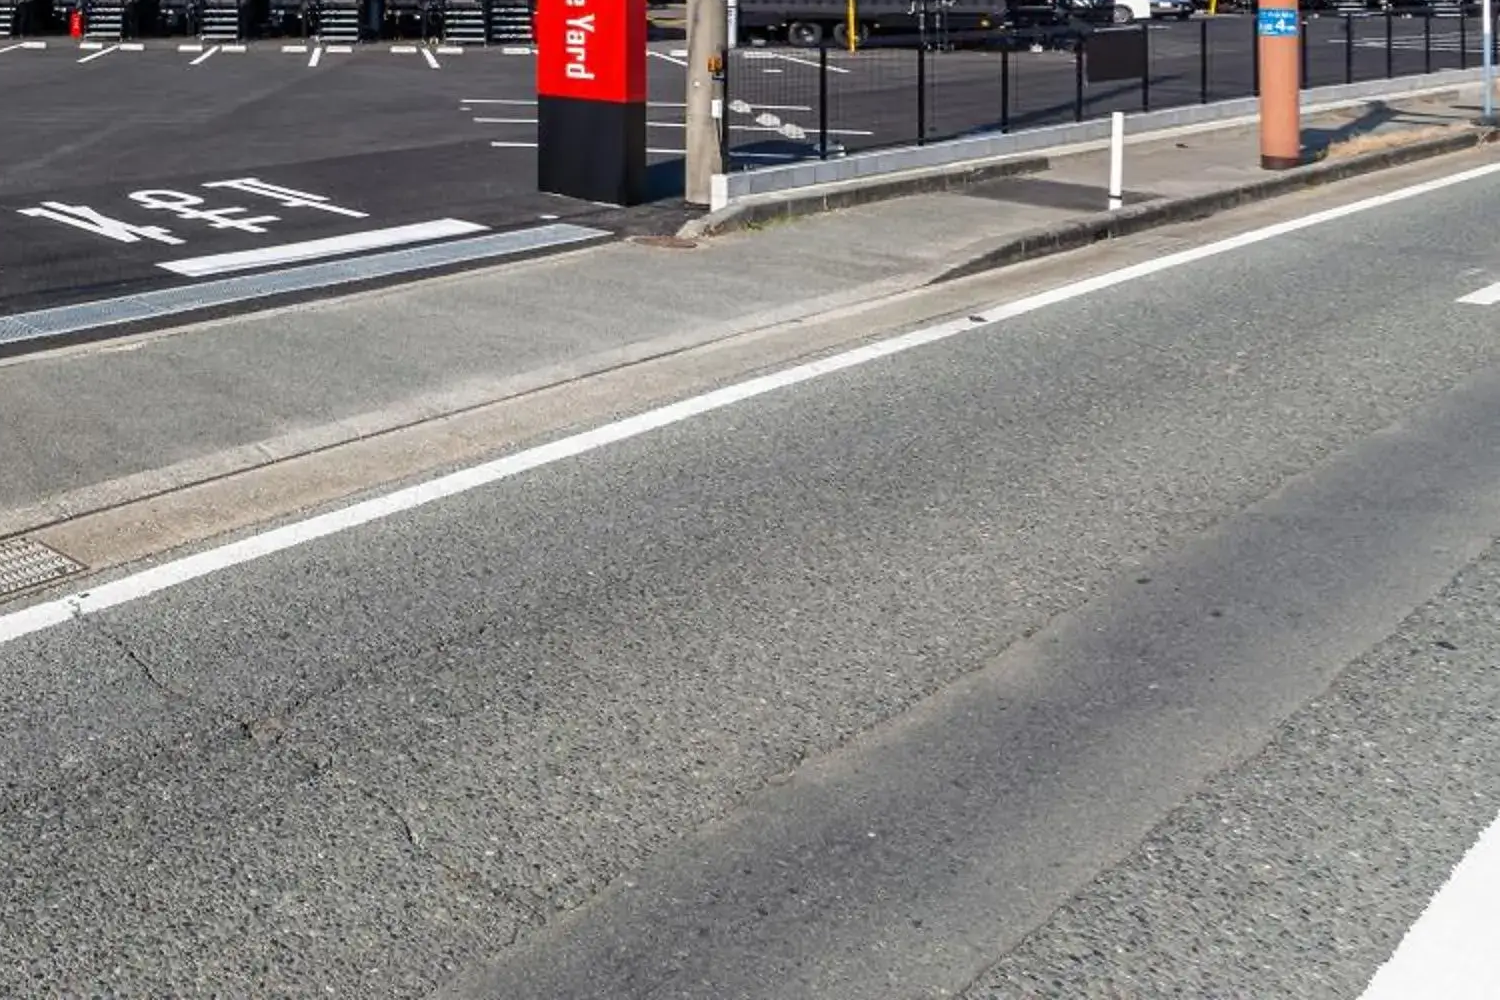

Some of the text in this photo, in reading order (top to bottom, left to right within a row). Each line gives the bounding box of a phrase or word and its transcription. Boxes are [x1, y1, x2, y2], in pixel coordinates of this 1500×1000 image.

[565, 13, 596, 80] Yard
[16, 177, 370, 246] 止まれ
